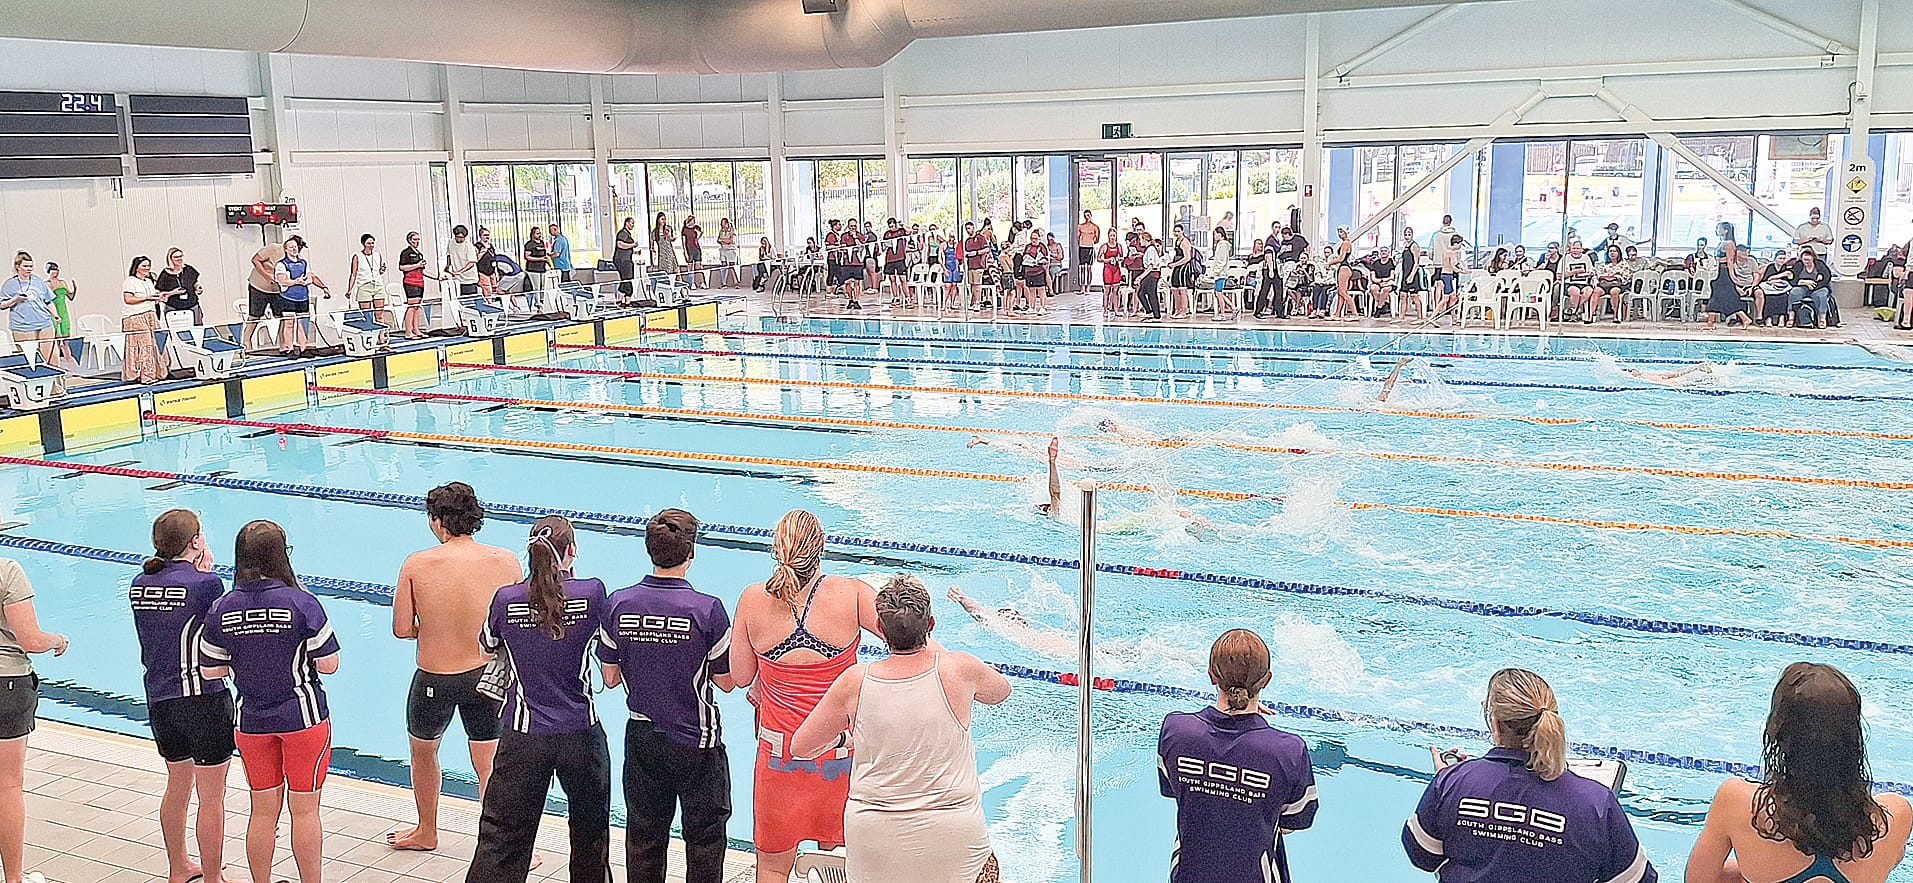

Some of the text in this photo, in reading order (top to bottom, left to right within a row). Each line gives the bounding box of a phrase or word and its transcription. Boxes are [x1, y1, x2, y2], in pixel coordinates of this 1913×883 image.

[62, 94, 102, 112] 22.4
[1848, 163, 1866, 172] 2m
[284, 196, 296, 204] 2m
[658, 292, 665, 303] 8
[572, 304, 579, 317] 7
[470, 319, 478, 332] 6
[347, 337, 356, 352] 5
[198, 359, 206, 376] 4
[10, 386, 21, 405] 3
[130, 586, 187, 600] SGB
[221, 608, 292, 626] SGB
[507, 599, 588, 617] SB
[618, 614, 691, 632] SGB
[1177, 756, 1271, 789] SGB
[1178, 776, 1201, 785] SOUTH
[1203, 781, 1246, 794] GIPPSLAND
[1189, 786, 1252, 804] SWIMMING CLUB
[1458, 797, 1566, 833] SGB
[1457, 819, 1563, 845] SOUTH GIPPSLAND BASS
[1472, 829, 1544, 848] SWIMMING CLUB
